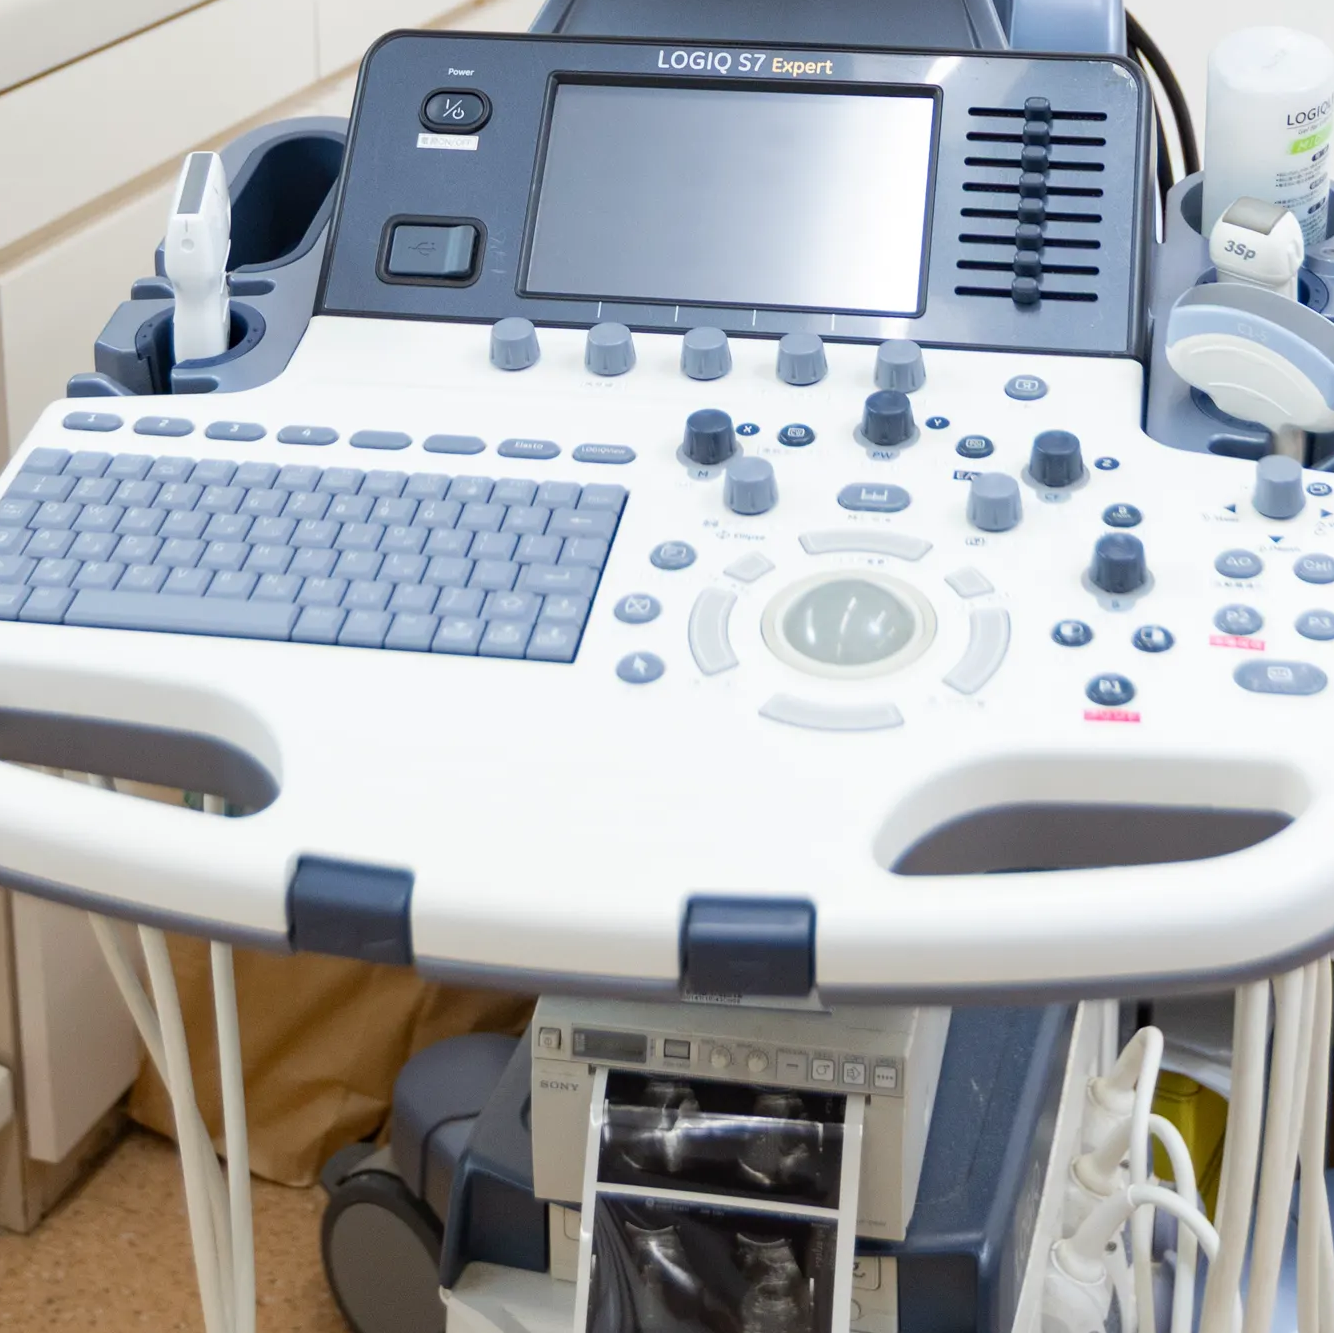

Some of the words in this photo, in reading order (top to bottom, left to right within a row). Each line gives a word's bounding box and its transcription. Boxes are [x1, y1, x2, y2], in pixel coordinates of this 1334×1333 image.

[657, 50, 731, 75] LOGIQ
[739, 52, 767, 72] S7
[771, 56, 833, 78] Expert
[448, 67, 475, 76] Power
[1224, 239, 1256, 261] 3Sp
[515, 440, 544, 450] Elasto
[581, 446, 627, 455] LOGIQView
[872, 450, 895, 459] PW
[539, 1079, 579, 1093] SONY
